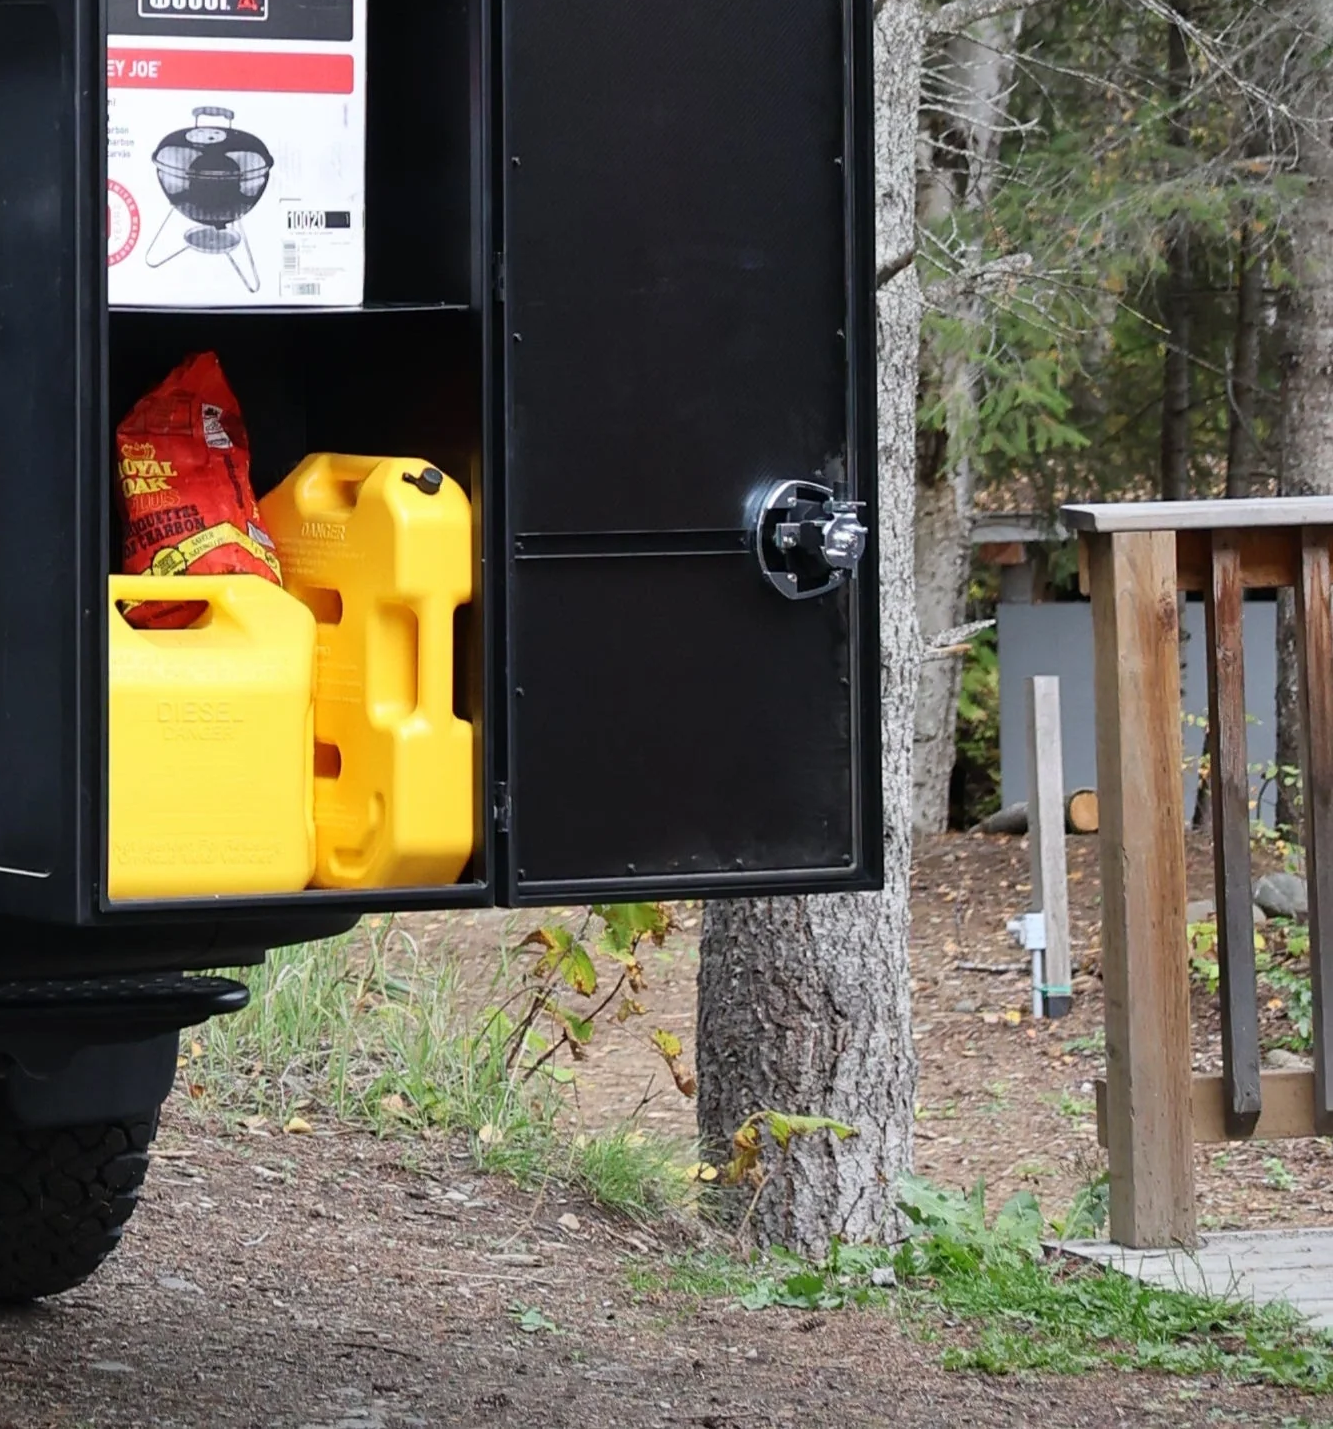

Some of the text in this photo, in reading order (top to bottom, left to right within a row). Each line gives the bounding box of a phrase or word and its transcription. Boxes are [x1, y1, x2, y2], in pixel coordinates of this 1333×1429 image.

[128, 59, 159, 79] JOE
[117, 458, 178, 479] OYAL
[123, 477, 172, 499] OAK
[301, 521, 346, 541] DANGER
[154, 700, 244, 724] DIESEL
[161, 725, 237, 742] DANGER
